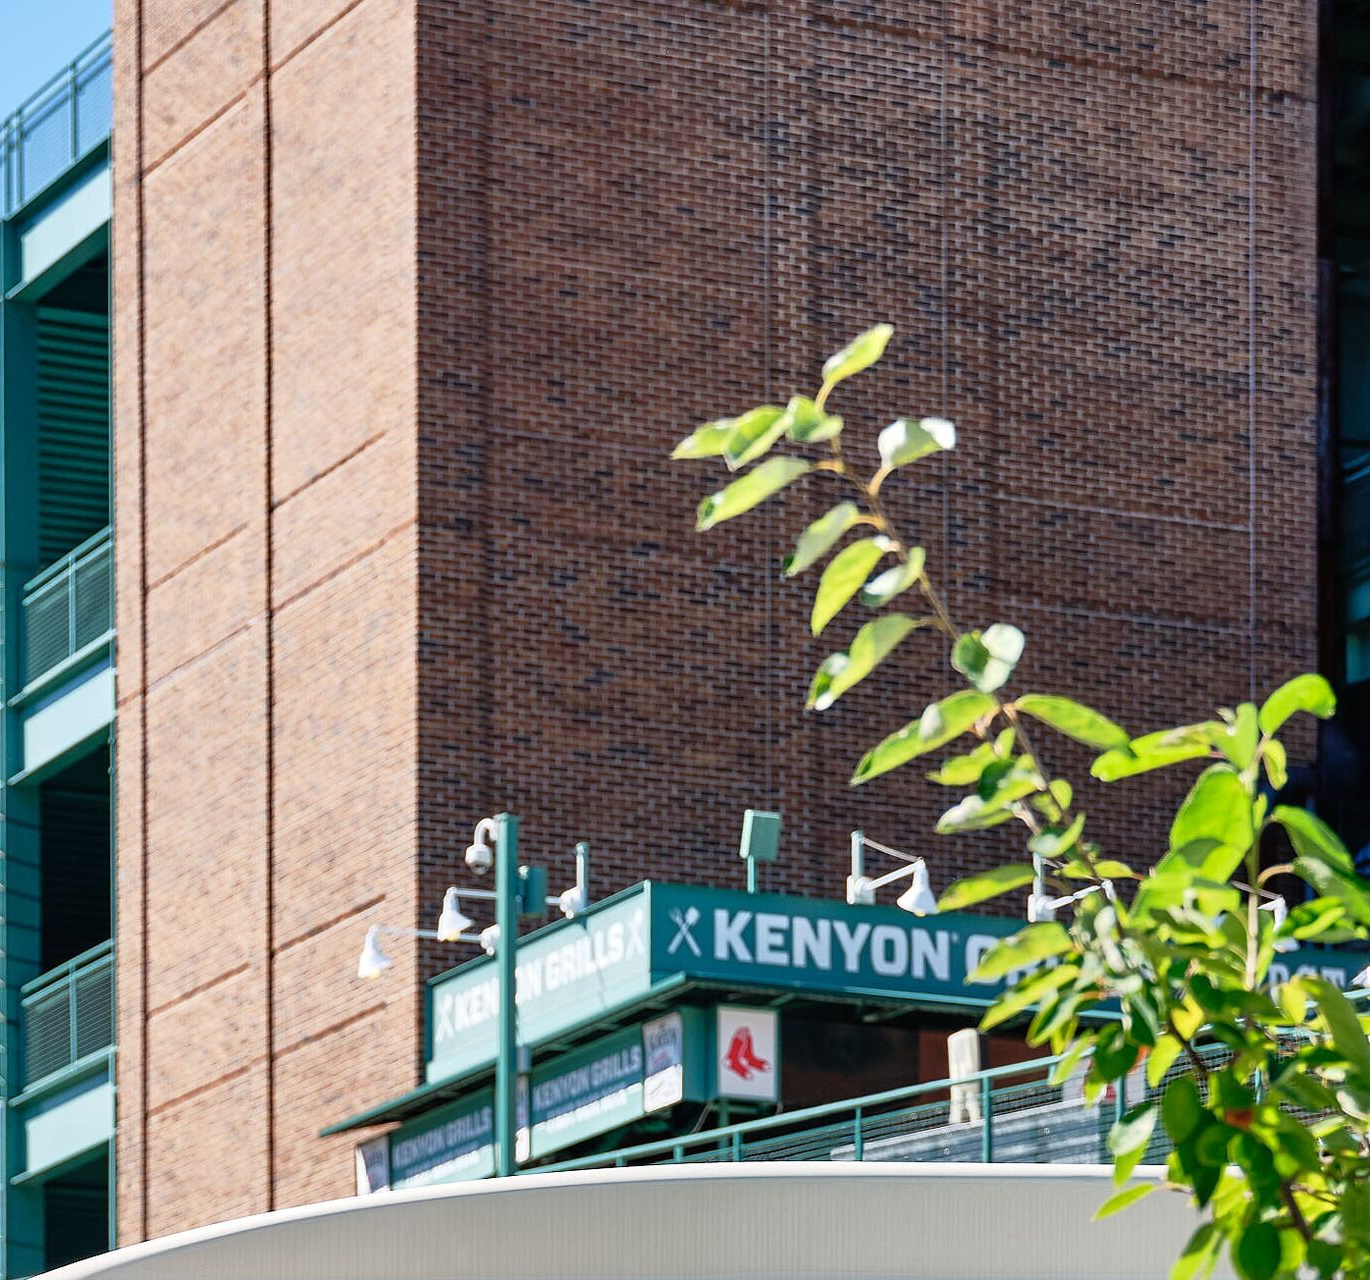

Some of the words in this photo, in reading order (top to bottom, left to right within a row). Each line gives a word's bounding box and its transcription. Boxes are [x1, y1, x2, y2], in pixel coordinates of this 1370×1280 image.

[544, 920, 625, 991] GRILLS
[713, 907, 951, 982] KENYON
[532, 1064, 591, 1112] KENYON
[591, 1044, 640, 1088] GRILLS
